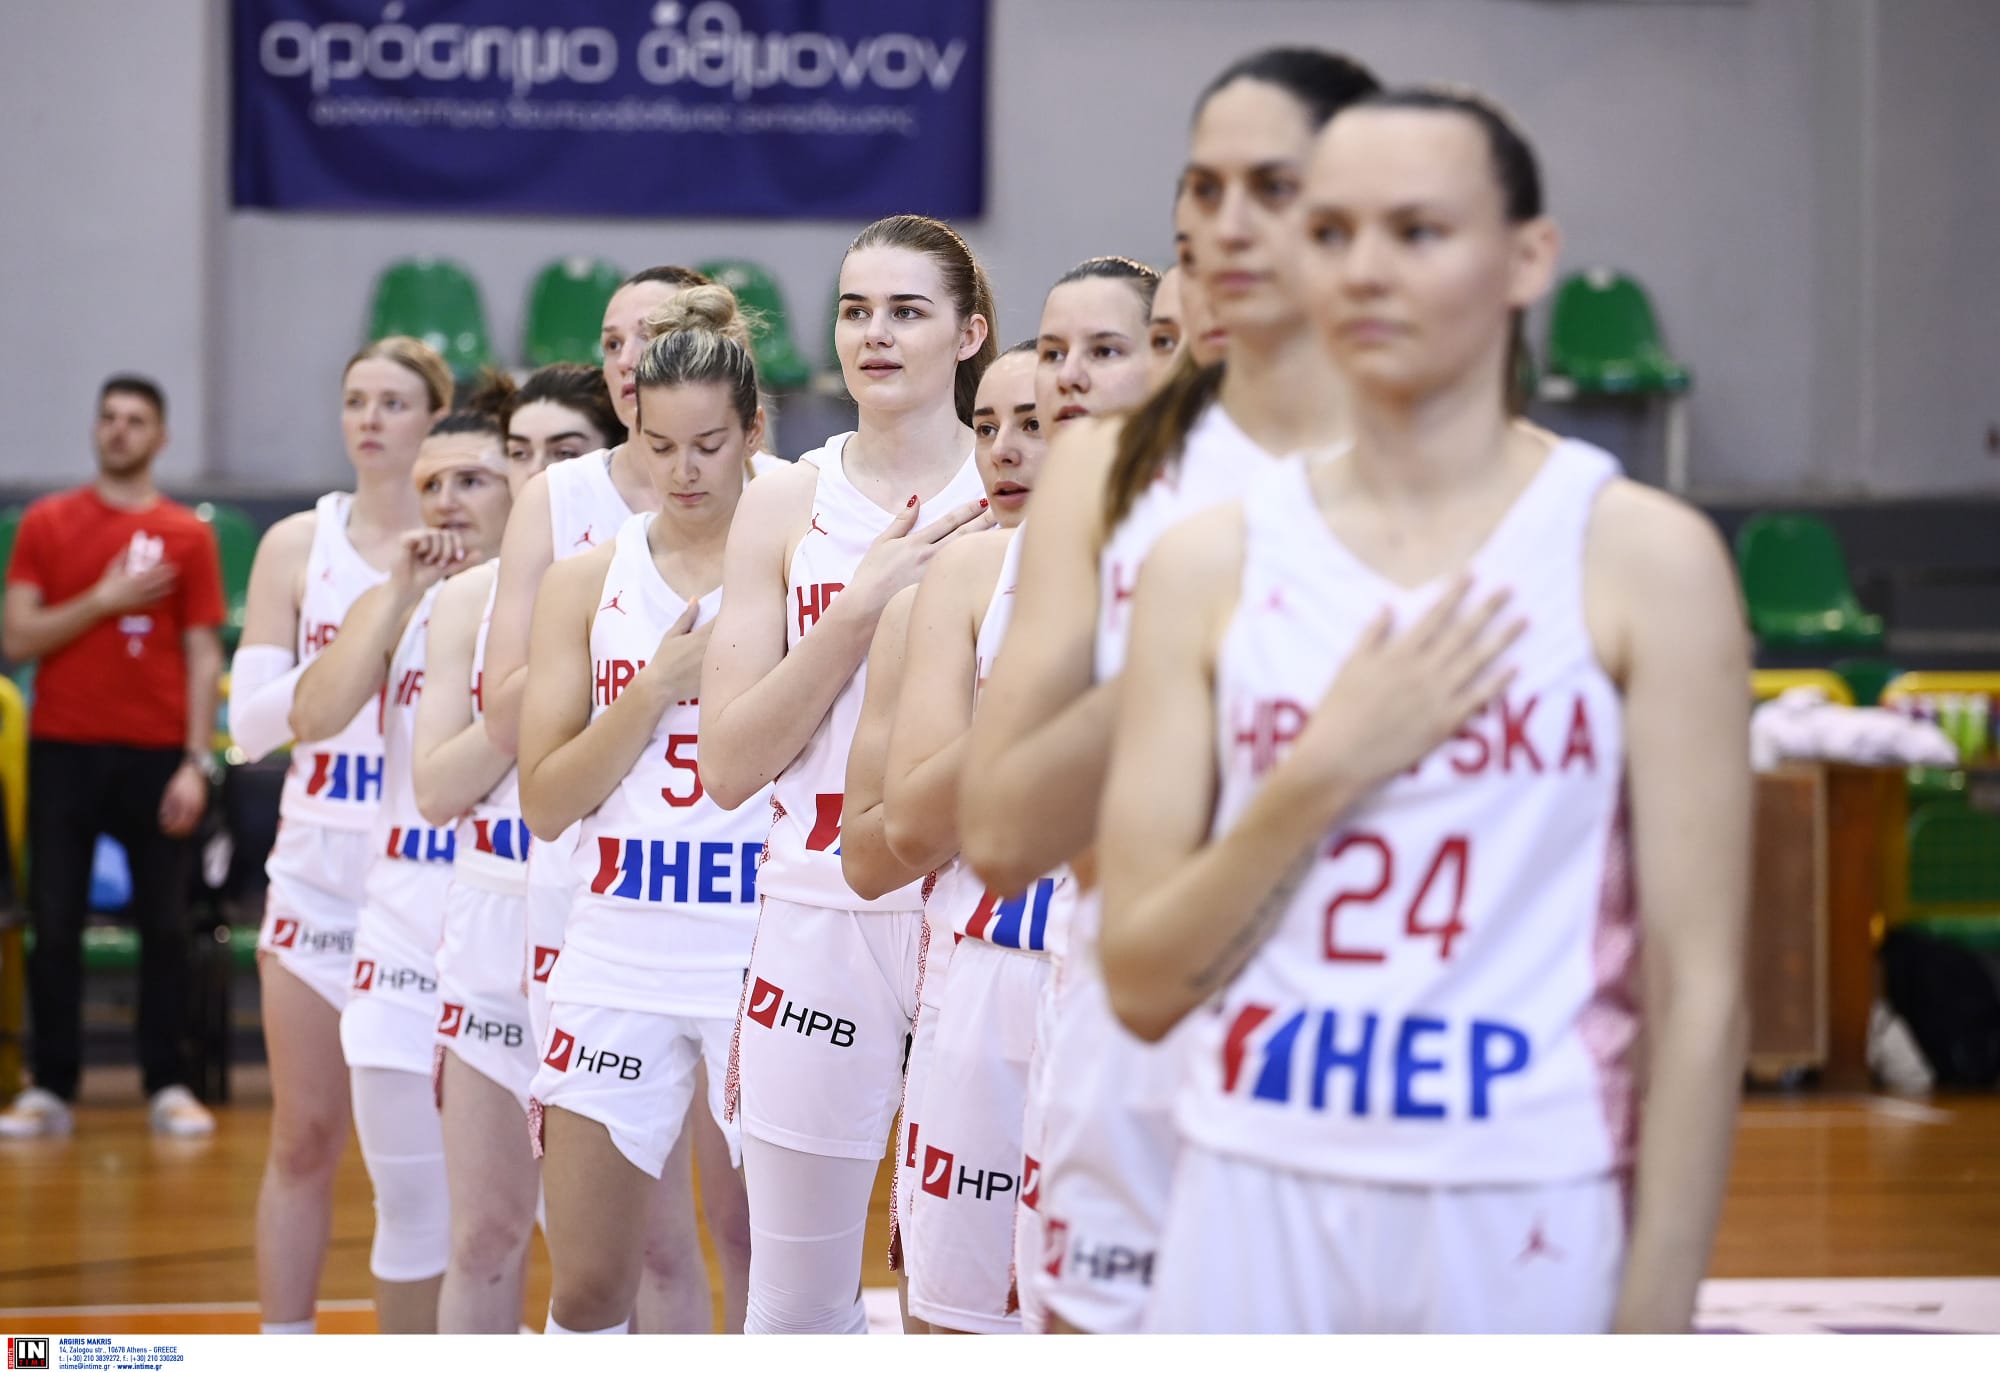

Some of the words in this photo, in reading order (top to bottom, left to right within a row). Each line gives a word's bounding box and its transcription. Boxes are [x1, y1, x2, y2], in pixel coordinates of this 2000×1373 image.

[1232, 692, 1596, 776] HRSKA
[661, 733, 704, 807] 5
[1320, 828, 1472, 965] 24
[464, 1014, 523, 1048] HPB
[780, 1000, 857, 1048] HPB
[576, 1045, 643, 1081] HPB
[1308, 1008, 1533, 1121] HEP
[957, 1165, 1020, 1203] HP
